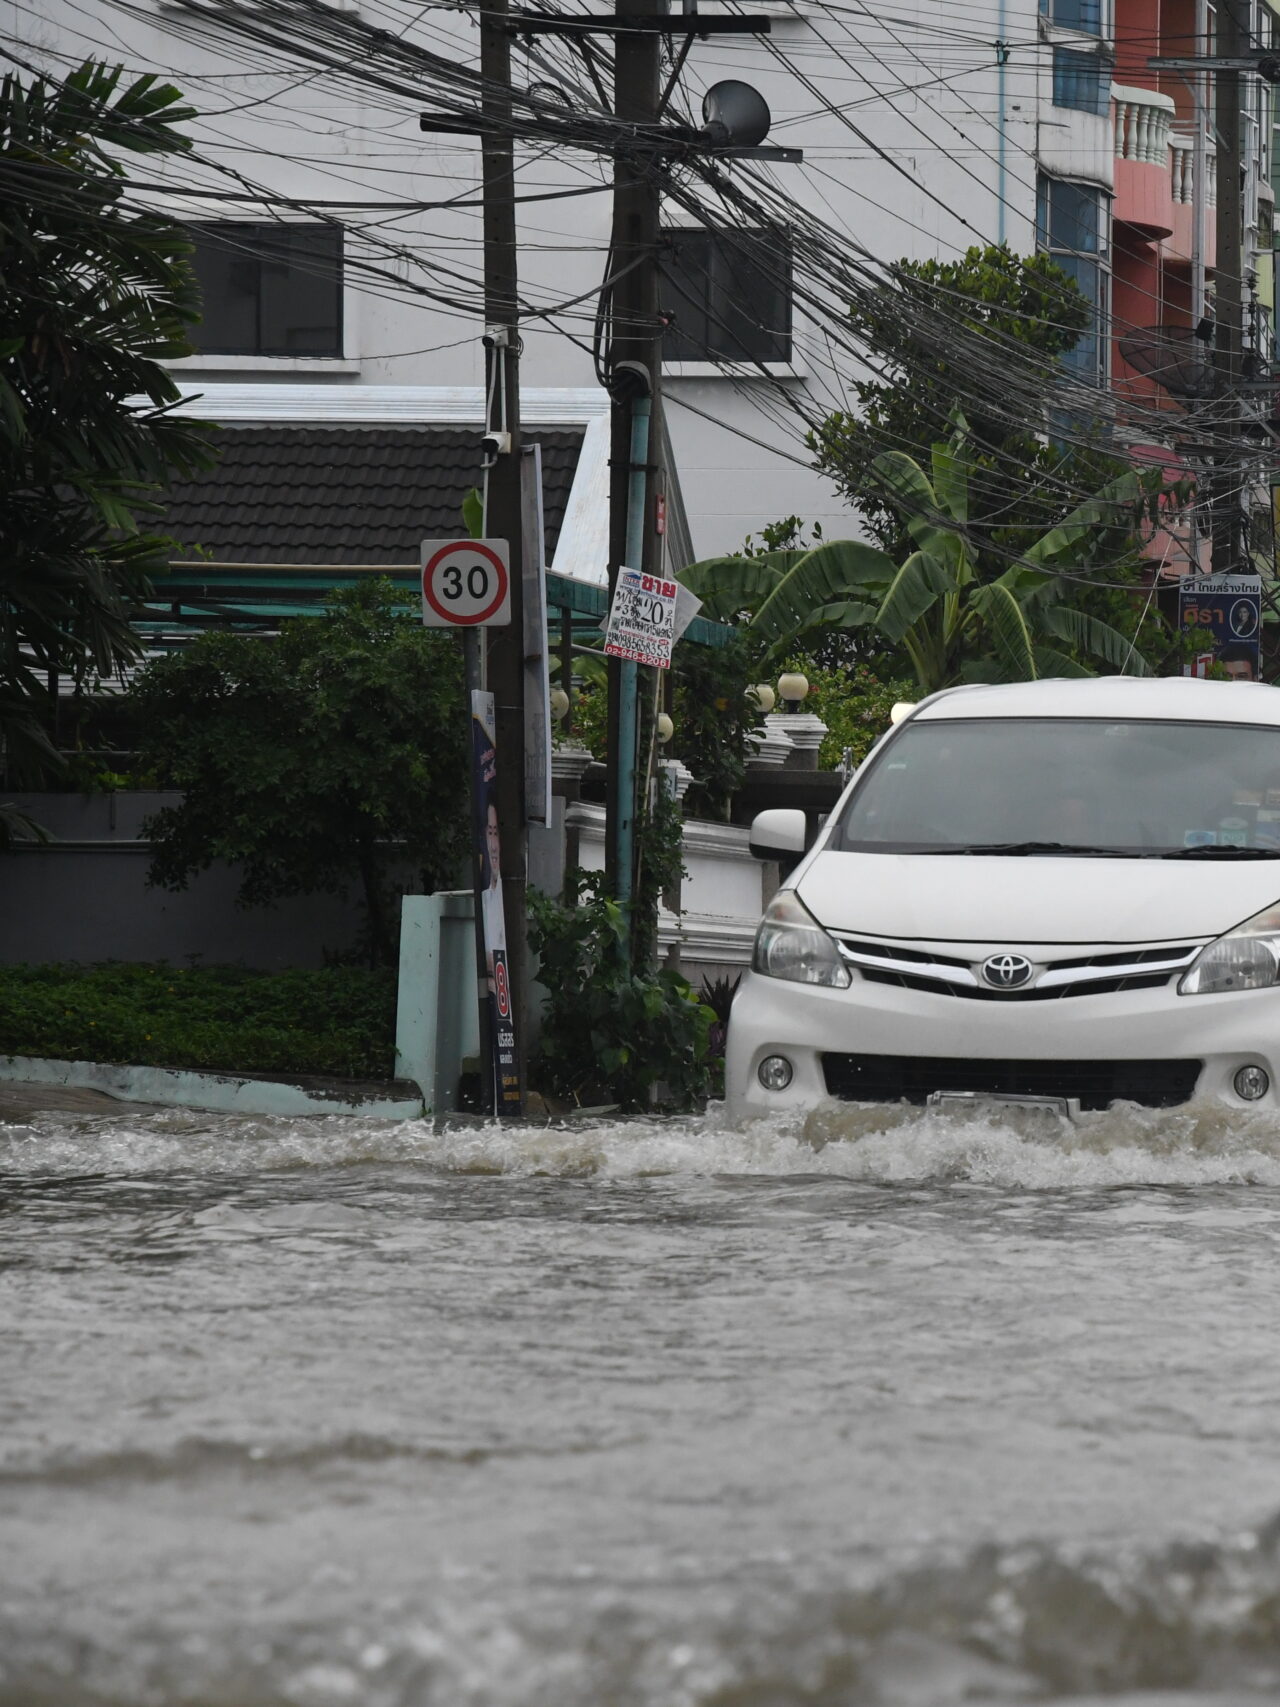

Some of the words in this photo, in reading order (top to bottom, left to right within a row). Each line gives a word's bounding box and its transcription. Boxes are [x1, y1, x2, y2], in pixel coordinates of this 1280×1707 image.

[442, 565, 488, 600] 30
[641, 575, 676, 598] ขาย
[1198, 582, 1259, 593] ไทยสร้างไทย
[641, 598, 664, 625] 20
[496, 962, 509, 1017] 8
